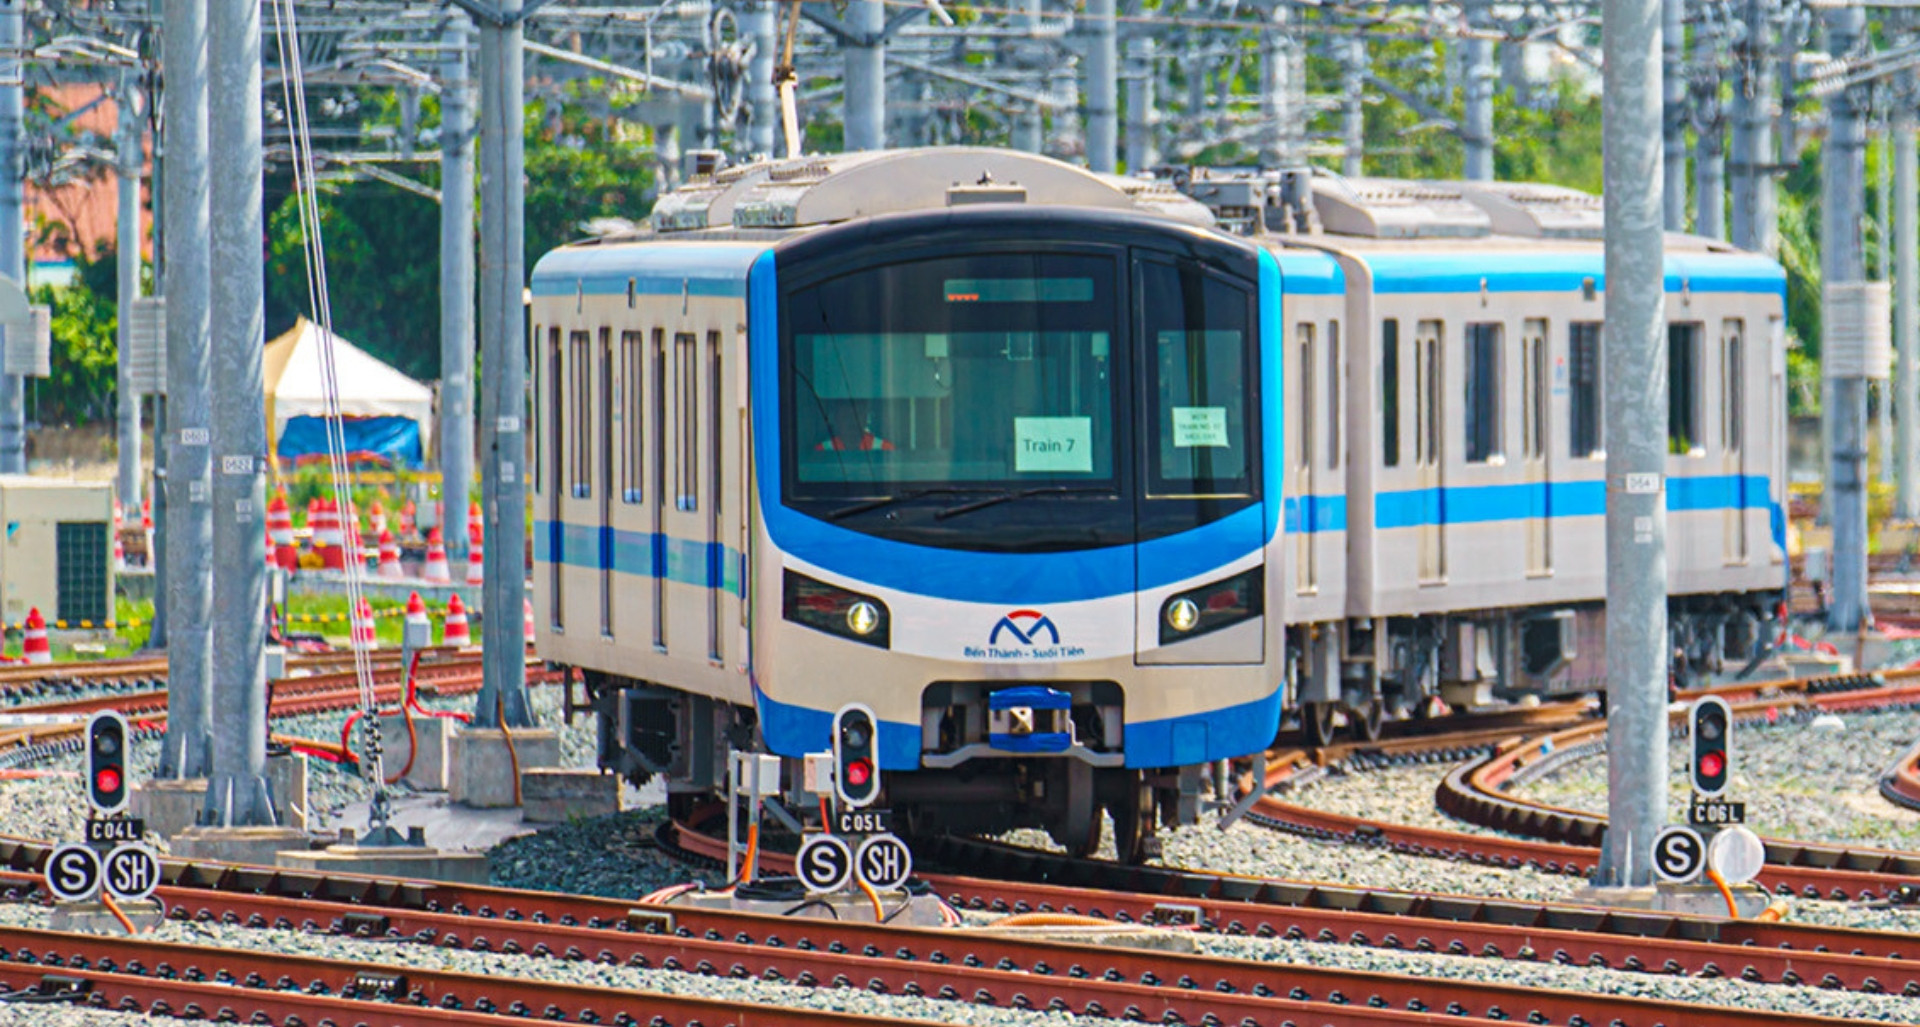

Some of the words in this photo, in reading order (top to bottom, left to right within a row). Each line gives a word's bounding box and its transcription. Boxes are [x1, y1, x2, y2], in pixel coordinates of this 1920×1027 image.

[1023, 438, 1062, 453] Train
[1065, 438, 1075, 453] 7
[92, 821, 137, 840] C04L
[841, 814, 886, 832] C05L
[1695, 804, 1739, 823] C06L
[60, 853, 87, 891] S
[114, 853, 149, 892] SH
[811, 845, 838, 883] S
[867, 844, 900, 882] SH
[1664, 836, 1691, 873] S
